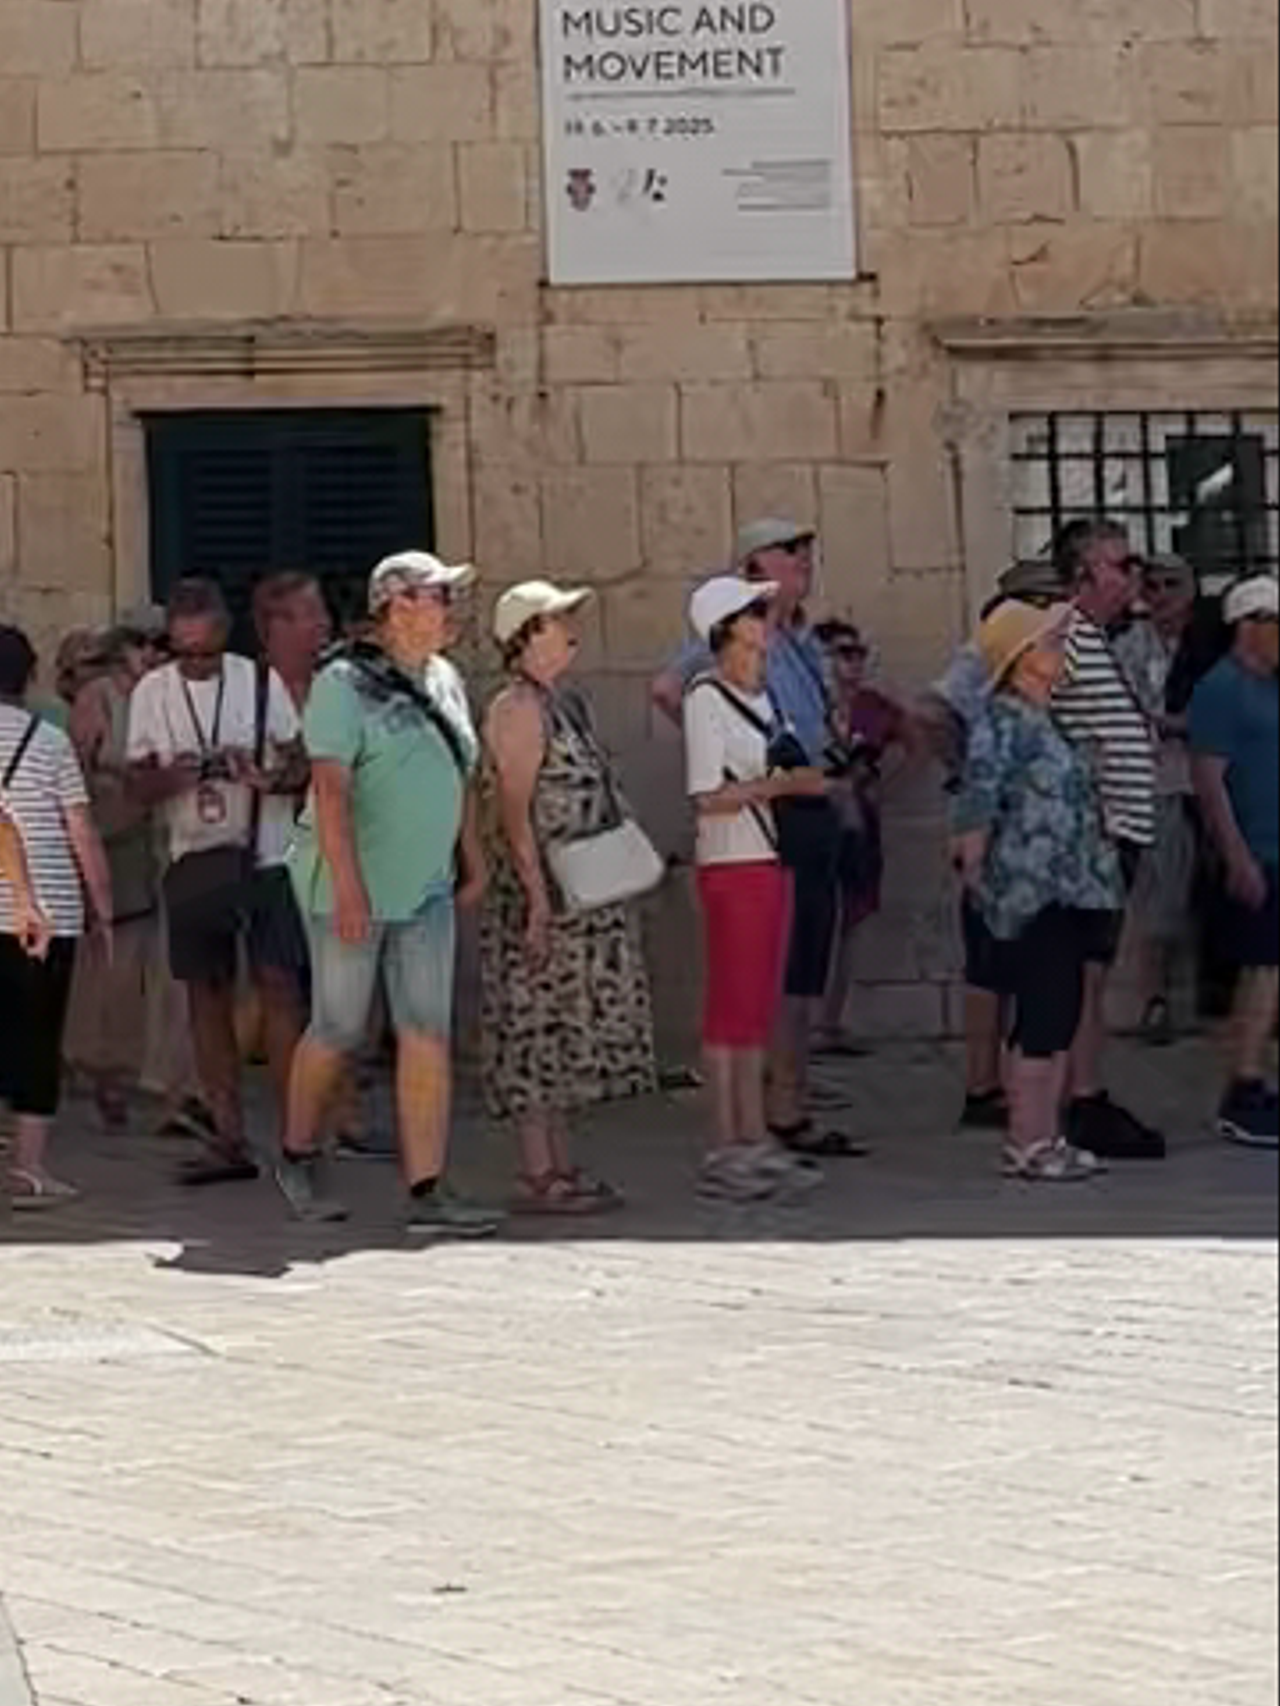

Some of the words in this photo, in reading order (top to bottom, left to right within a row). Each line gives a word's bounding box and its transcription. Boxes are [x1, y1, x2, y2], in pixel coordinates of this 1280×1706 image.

[562, 7, 683, 39] MUSIC
[691, 3, 777, 35] AND
[562, 48, 785, 83] MOVEMENT
